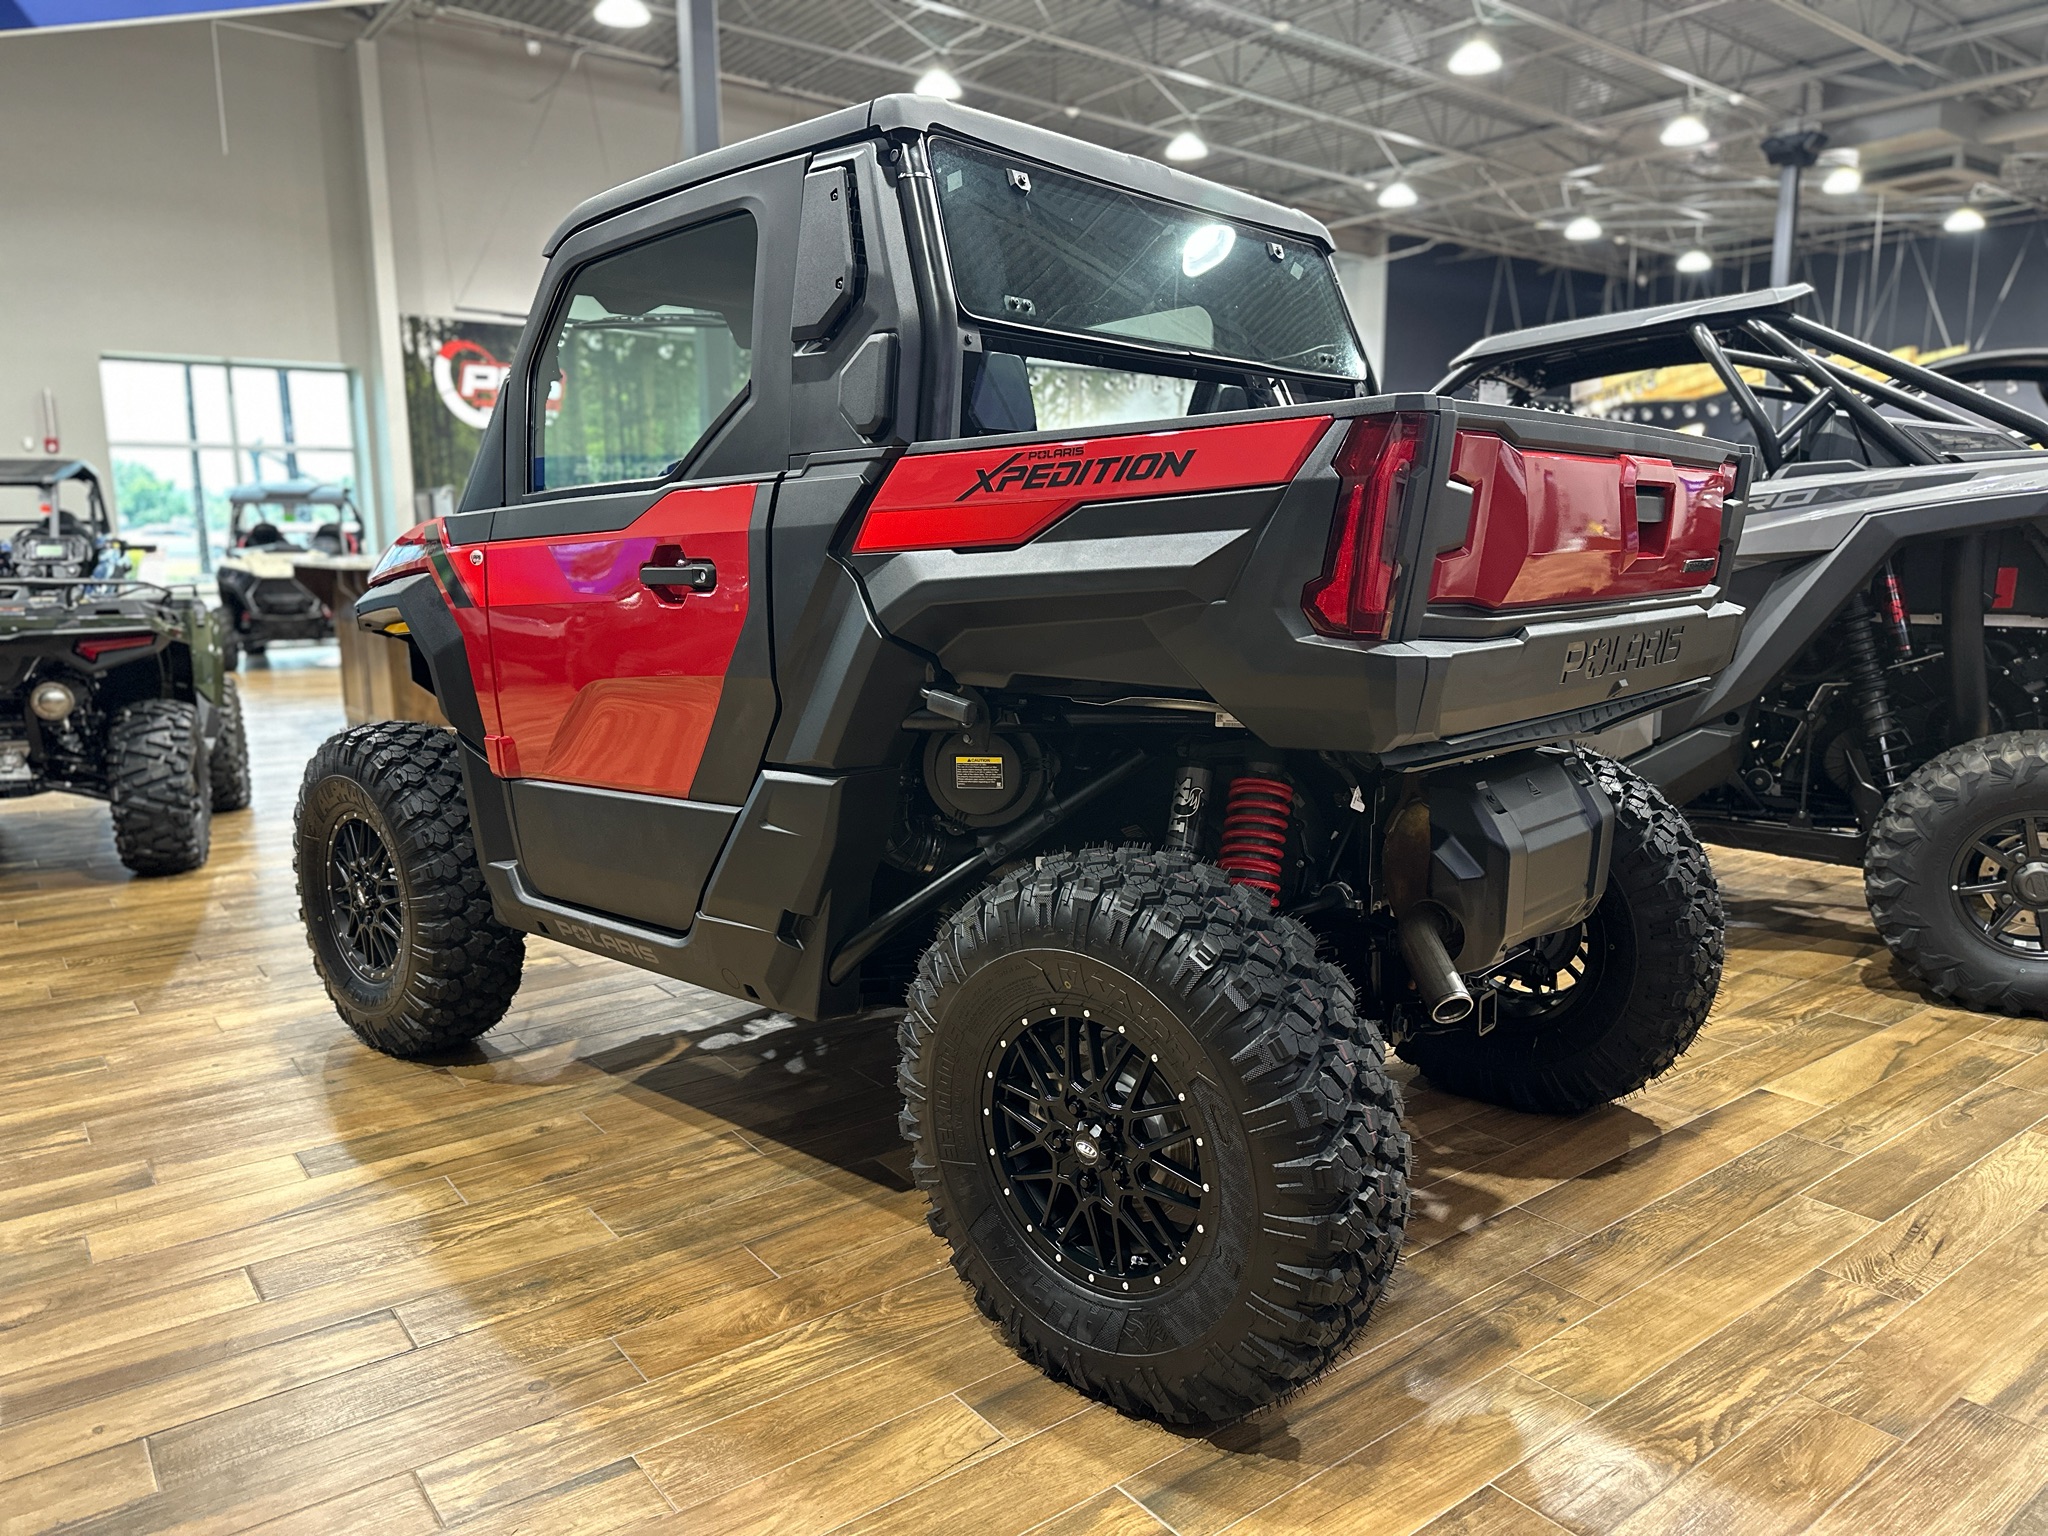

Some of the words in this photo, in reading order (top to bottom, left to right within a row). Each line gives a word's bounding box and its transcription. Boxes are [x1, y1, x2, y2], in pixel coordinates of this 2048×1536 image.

[953, 449, 1197, 502] XPEDITION
[1028, 446, 1084, 460] POLARIS
[1747, 487, 1820, 511] RO
[1559, 625, 1686, 684] POLARIS
[1168, 778, 1202, 833] FOX
[553, 919, 660, 964] POLARIS
